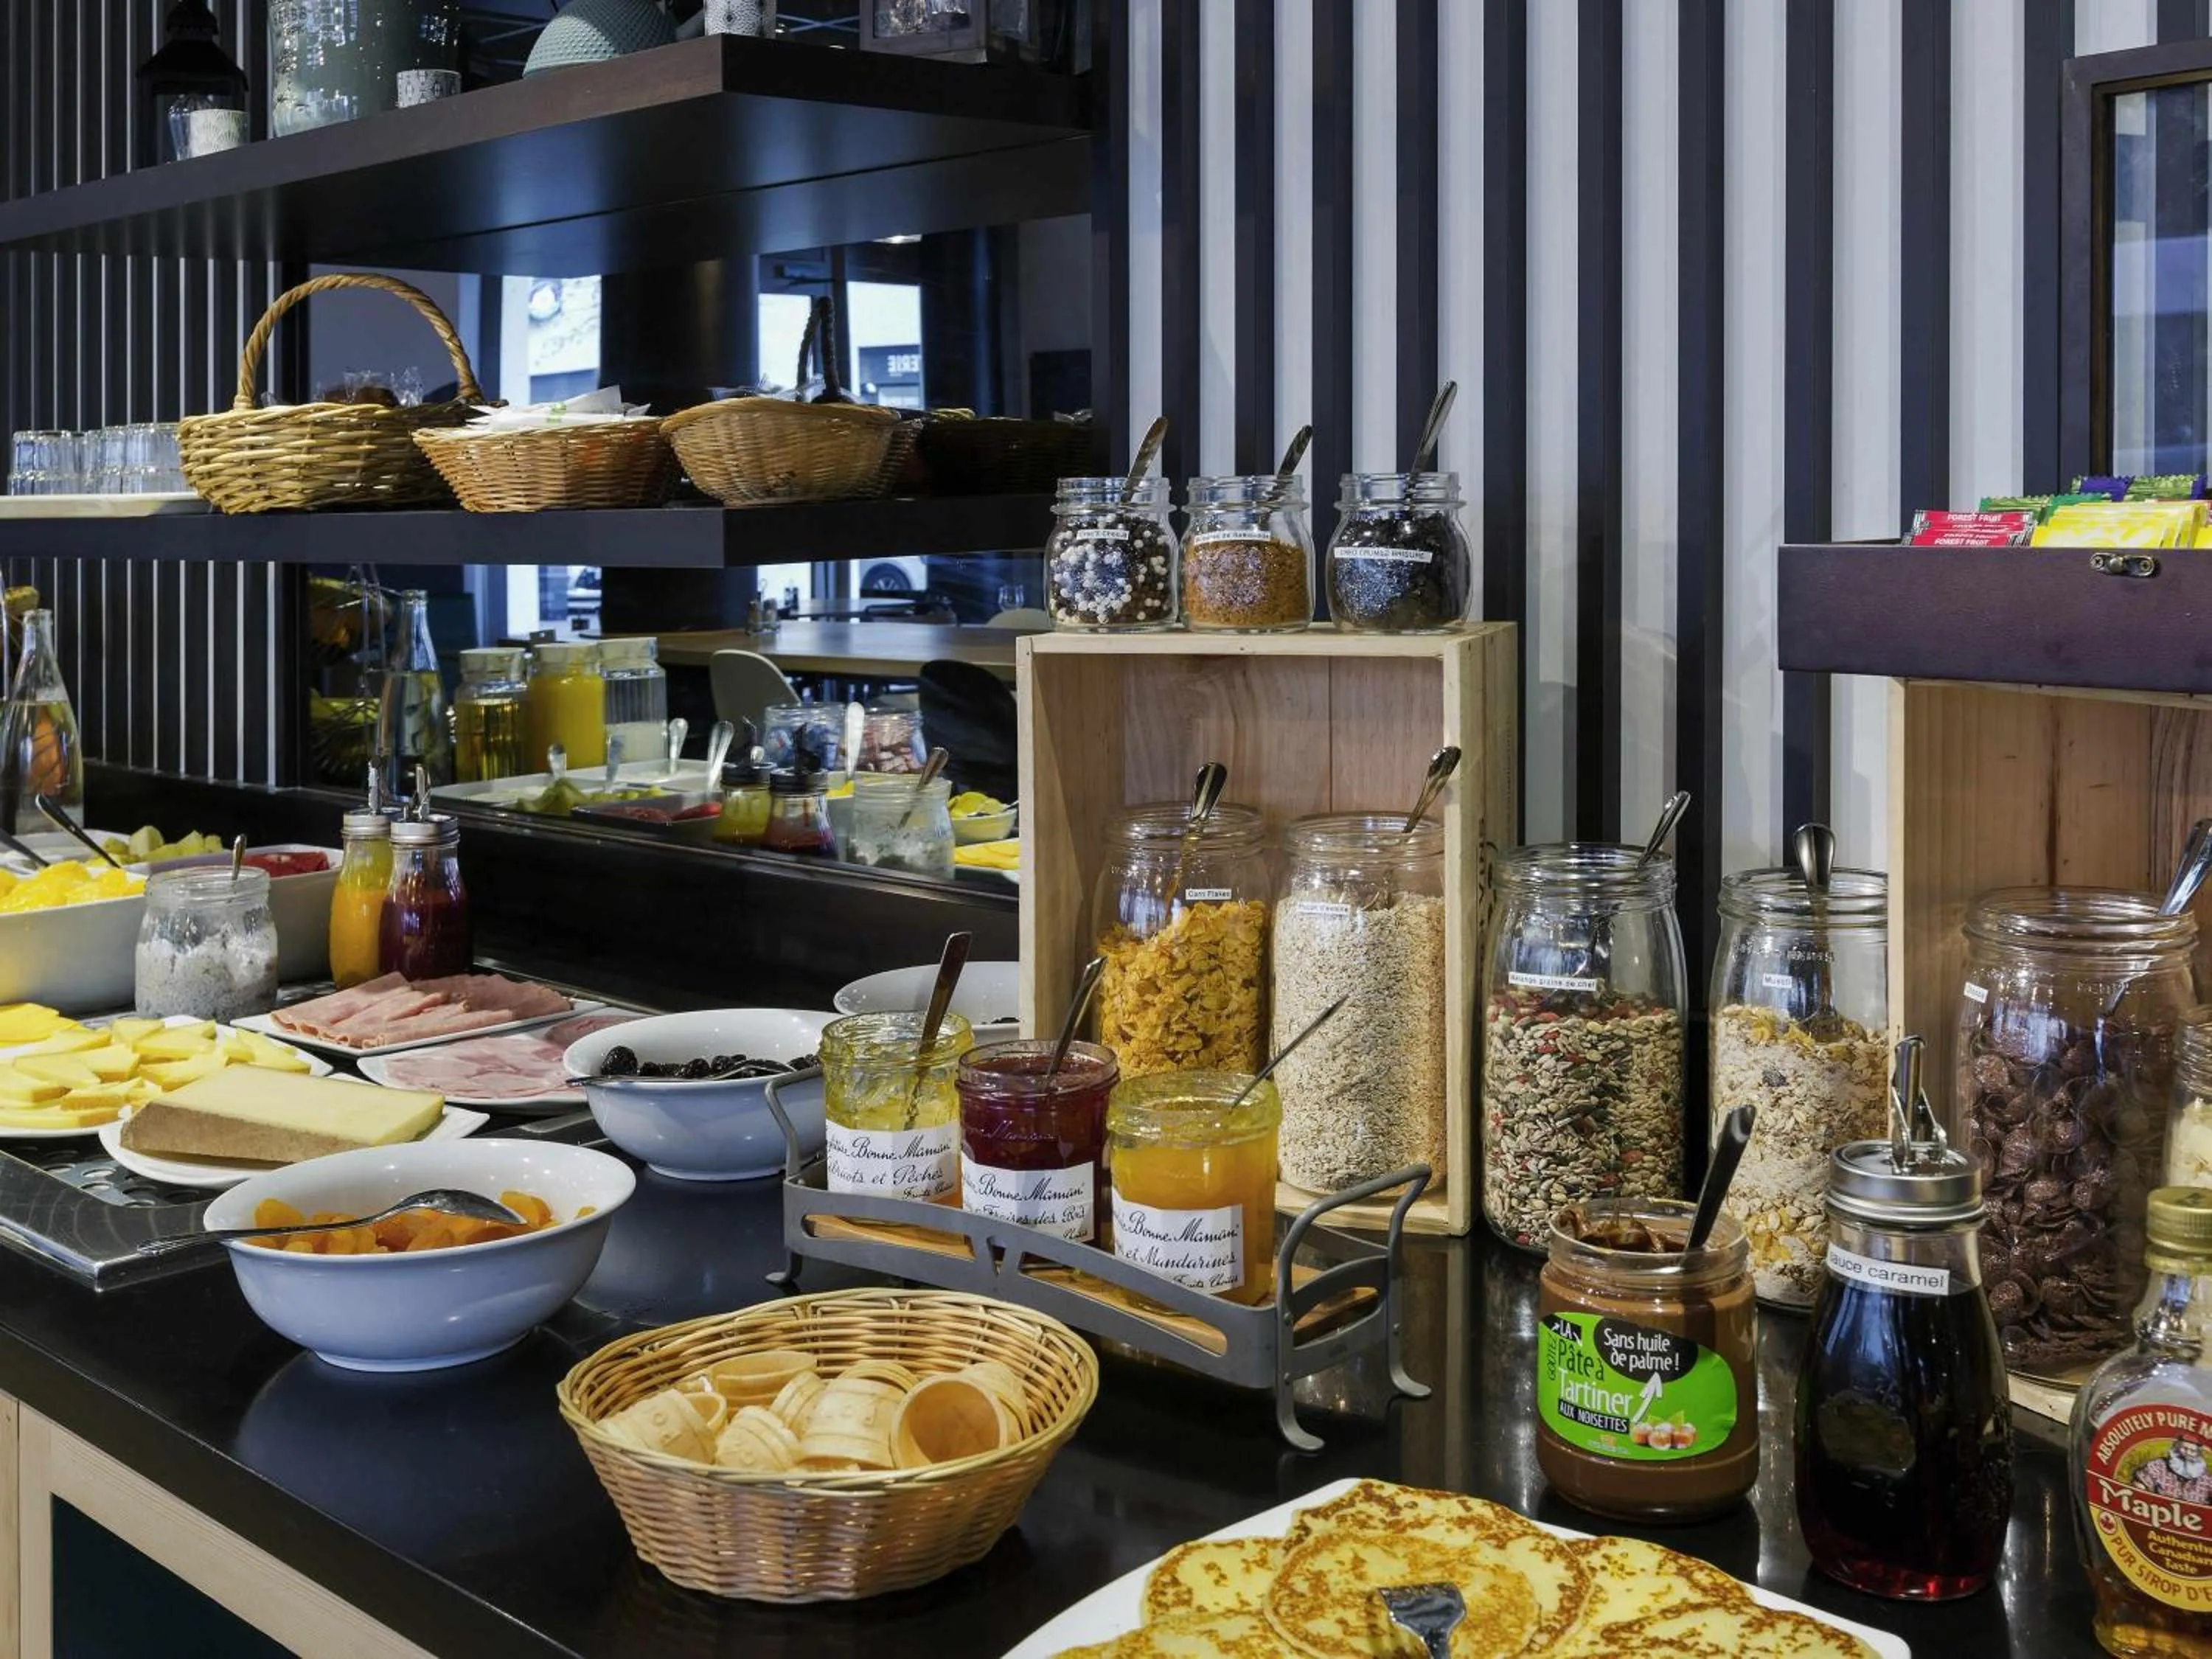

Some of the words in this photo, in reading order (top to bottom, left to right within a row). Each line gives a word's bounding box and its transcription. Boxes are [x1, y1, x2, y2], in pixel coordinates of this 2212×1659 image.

[1947, 514, 1976, 522] FOREST
[1978, 514, 2003, 522] FRUIT
[851, 1136, 897, 1160] Bonne
[898, 1133, 951, 1160] Maman
[978, 1173, 1023, 1201] Bonne
[1024, 1177, 1083, 1201] Maman
[1129, 1210, 1172, 1242] Bonne
[1173, 1217, 1239, 1242] Maman
[1829, 1252, 1862, 1273] auce
[1868, 1265, 1944, 1288] caramel
[1559, 1320, 1573, 1340] LA
[1604, 1327, 1635, 1349] Sans
[1637, 1331, 1671, 1352] huile
[1558, 1338, 1595, 1378] Pâte
[1595, 1357, 1605, 1381] à
[1610, 1346, 1627, 1366] de
[1558, 1367, 1634, 1416] Tartiner
[1559, 1402, 1575, 1419] AUX
[1578, 1410, 1628, 1432] NOISETTES
[2096, 1411, 2154, 1465] ABSOLUTELY
[2155, 1411, 2198, 1433] PURE
[2098, 1478, 2203, 1531] Maple
[2110, 1536, 2137, 1568] PUR
[2135, 1564, 2182, 1597] SIROP
